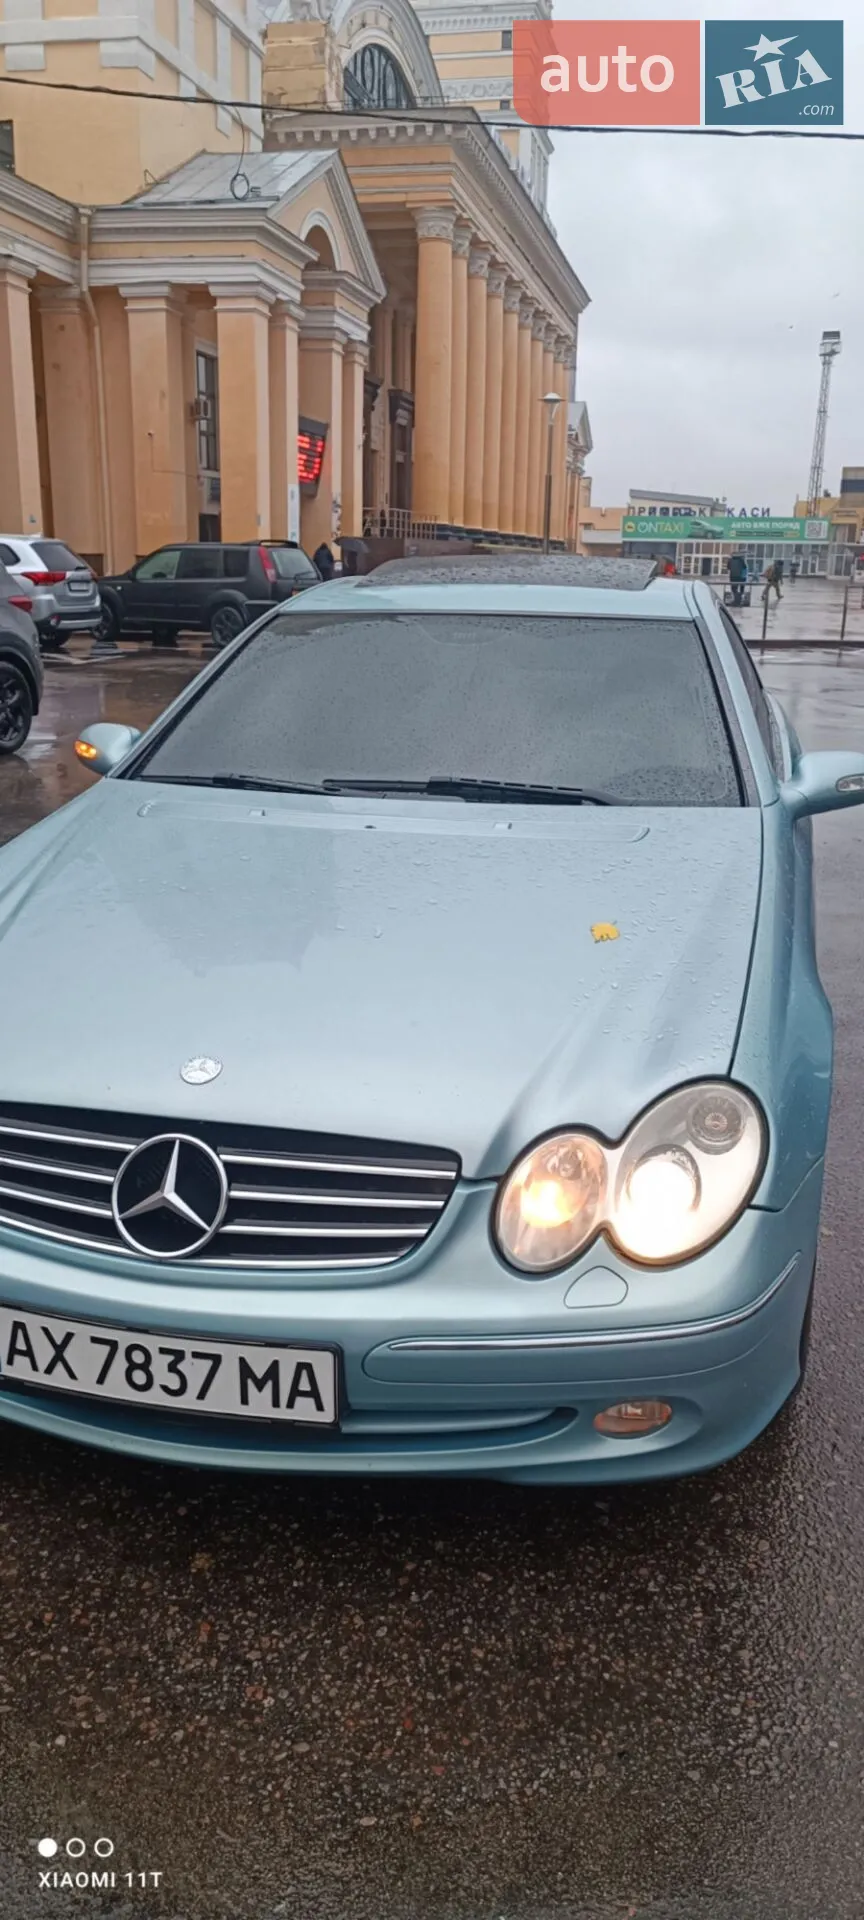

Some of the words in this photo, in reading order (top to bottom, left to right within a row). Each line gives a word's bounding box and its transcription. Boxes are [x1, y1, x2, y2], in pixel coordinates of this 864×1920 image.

[727, 507, 770, 518] КАСИ
[637, 521, 684, 534] ONTAXI
[6, 1320, 78, 1381] AX
[90, 1335, 222, 1400] 7837
[238, 1355, 325, 1412] MA
